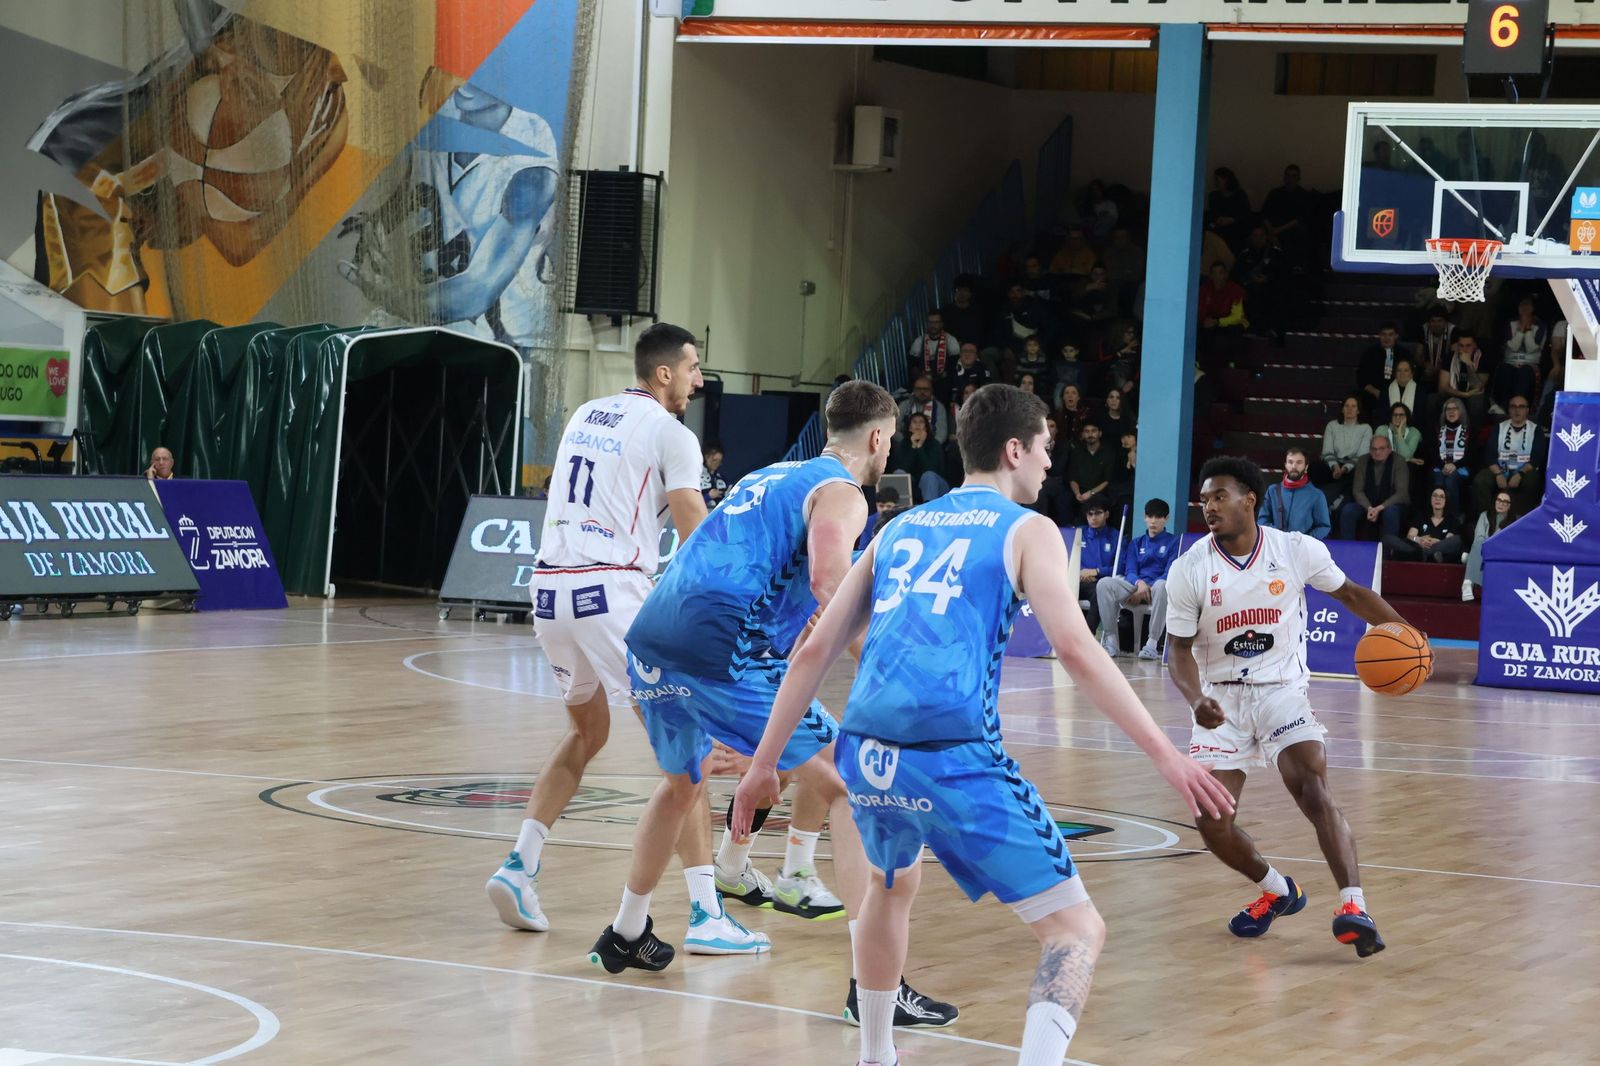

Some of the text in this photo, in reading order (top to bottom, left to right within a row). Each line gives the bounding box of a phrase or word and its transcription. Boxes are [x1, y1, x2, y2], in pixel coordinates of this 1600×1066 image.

[1489, 5, 1520, 47] 6
[17, 364, 39, 379] CON
[48, 367, 59, 377] WE
[49, 376, 67, 386] LOVE
[567, 455, 596, 508] 11
[51, 502, 169, 541] RURAL
[24, 551, 156, 577] DE ZAMORA
[210, 548, 270, 570] ZAMORA
[874, 538, 971, 615] 34
[1313, 607, 1339, 624] de
[1303, 627, 1336, 643] eón
[1490, 641, 1547, 662] CAJA
[1503, 663, 1527, 677] DE
[1272, 716, 1306, 739] MONBUS
[847, 790, 933, 813] MORALEJO
